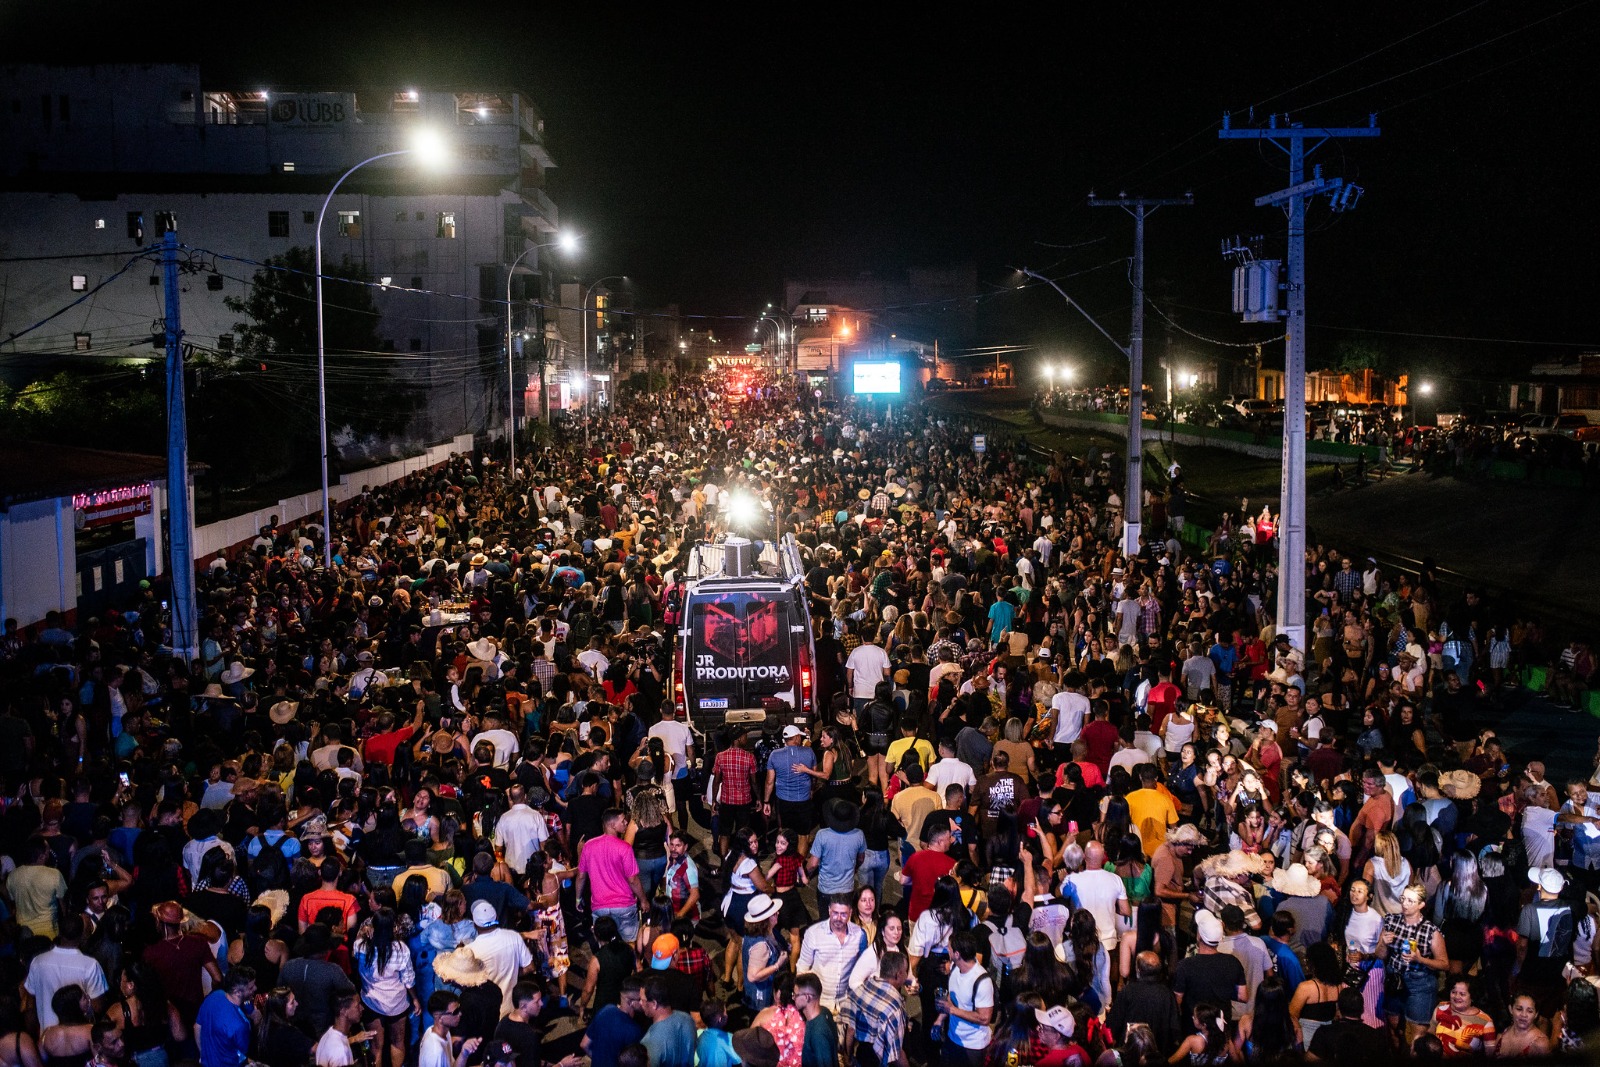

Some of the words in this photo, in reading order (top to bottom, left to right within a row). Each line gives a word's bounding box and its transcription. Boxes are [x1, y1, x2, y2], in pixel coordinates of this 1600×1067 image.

[695, 654, 714, 666] JR
[695, 665, 790, 679] PRODUTORA
[989, 786, 1014, 794] NORTH
